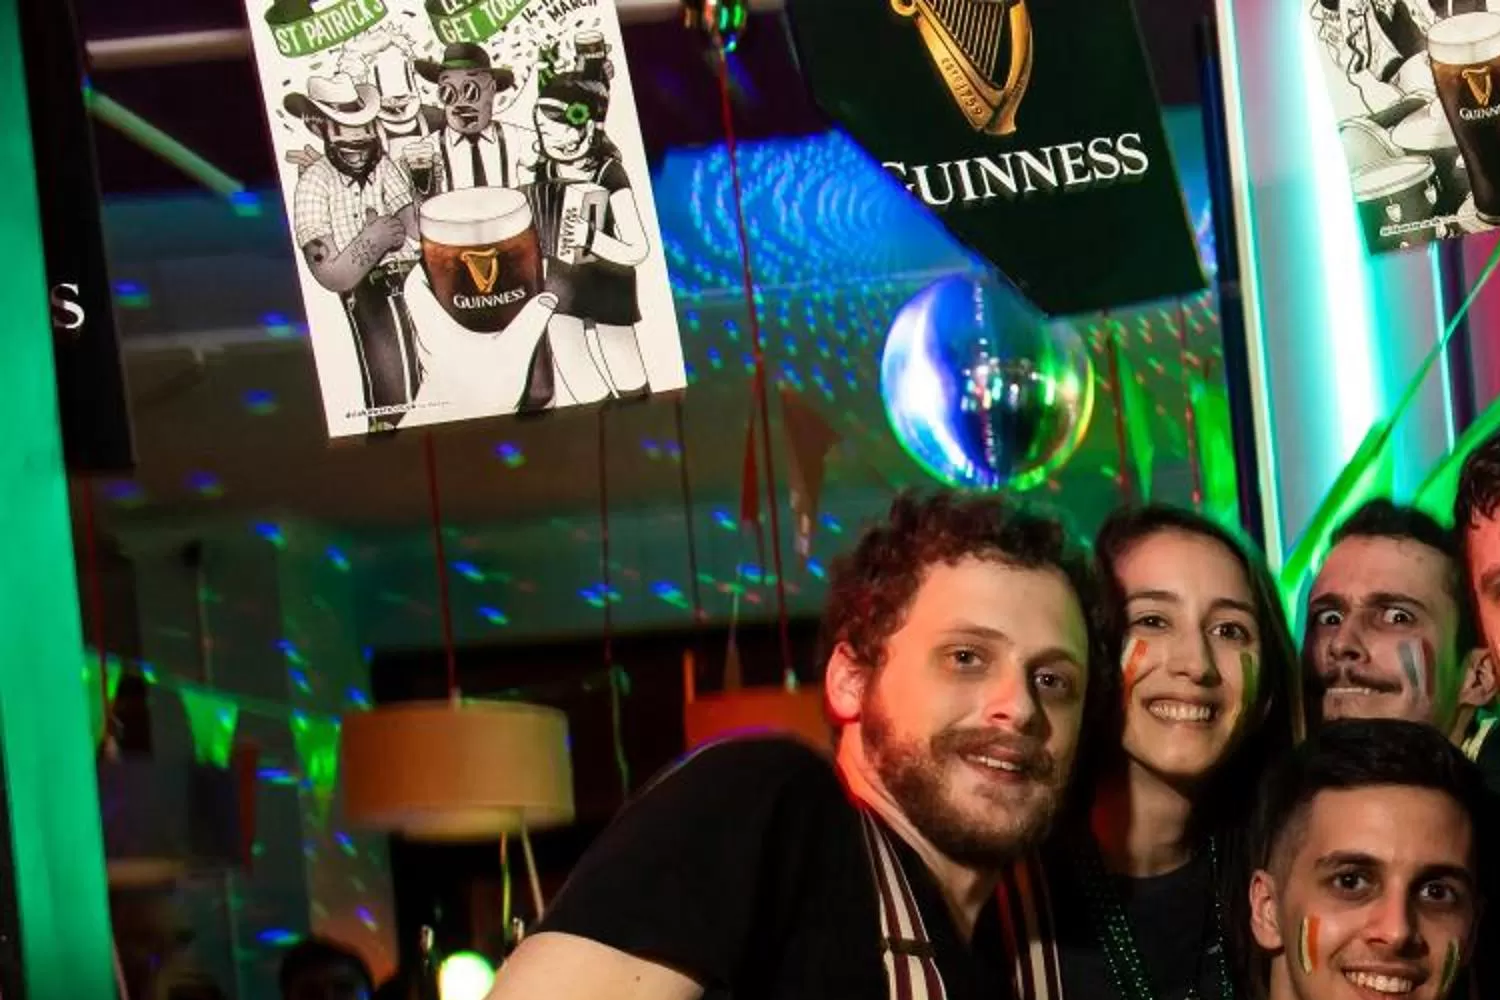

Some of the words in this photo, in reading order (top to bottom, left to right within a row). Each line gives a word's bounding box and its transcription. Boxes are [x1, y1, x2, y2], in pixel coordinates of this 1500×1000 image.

[275, 25, 301, 54] ST
[302, 0, 385, 48] PATRICK
[439, 12, 480, 43] GET
[453, 286, 528, 309] GUINNESS
